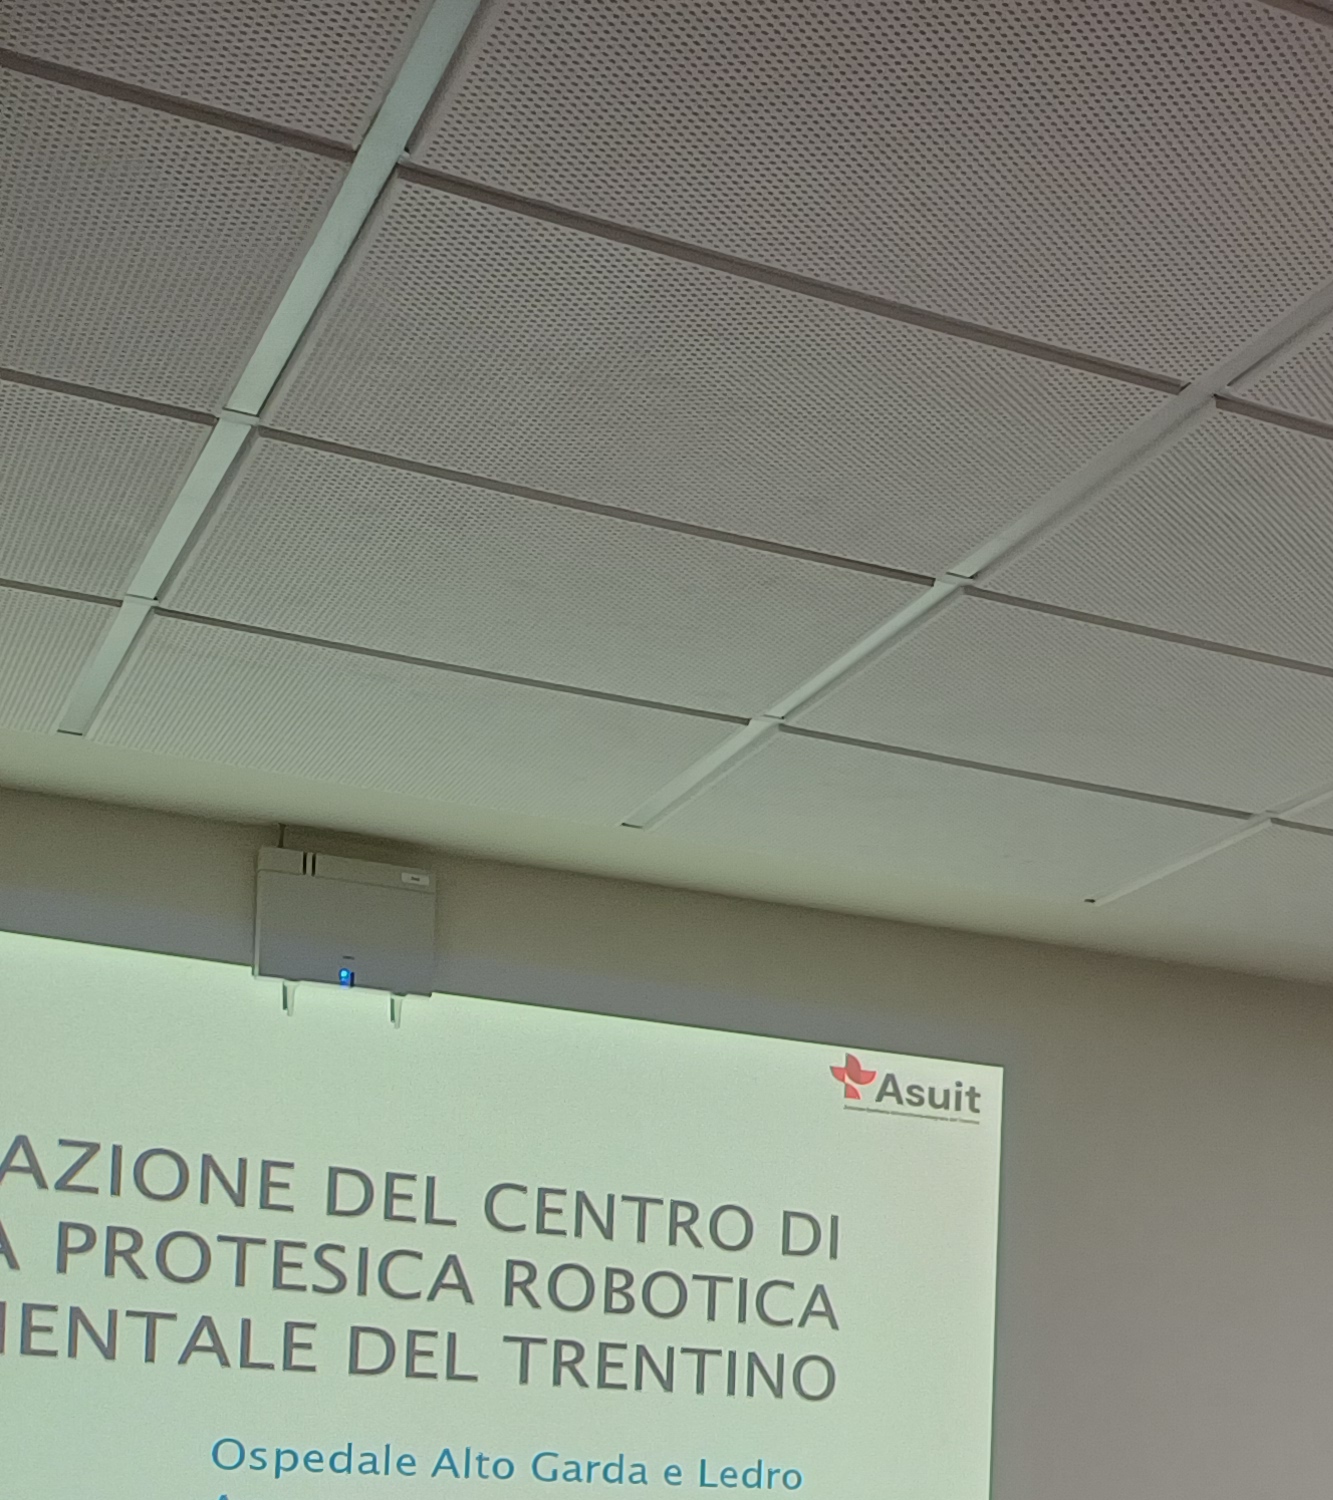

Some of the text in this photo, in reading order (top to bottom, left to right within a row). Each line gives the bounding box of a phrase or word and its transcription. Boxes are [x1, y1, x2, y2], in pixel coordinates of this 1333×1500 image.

[875, 1072, 981, 1114] Asuit
[0, 1134, 839, 1260] AZIONE DEL CENTRO DI
[56, 1221, 475, 1305] PROTESICA
[504, 1258, 840, 1331] ROBOTICA
[348, 1325, 479, 1382] DEL
[503, 1334, 837, 1401] TRENTINO
[211, 1437, 803, 1490] Ospedale Alto Garda e Ledro
